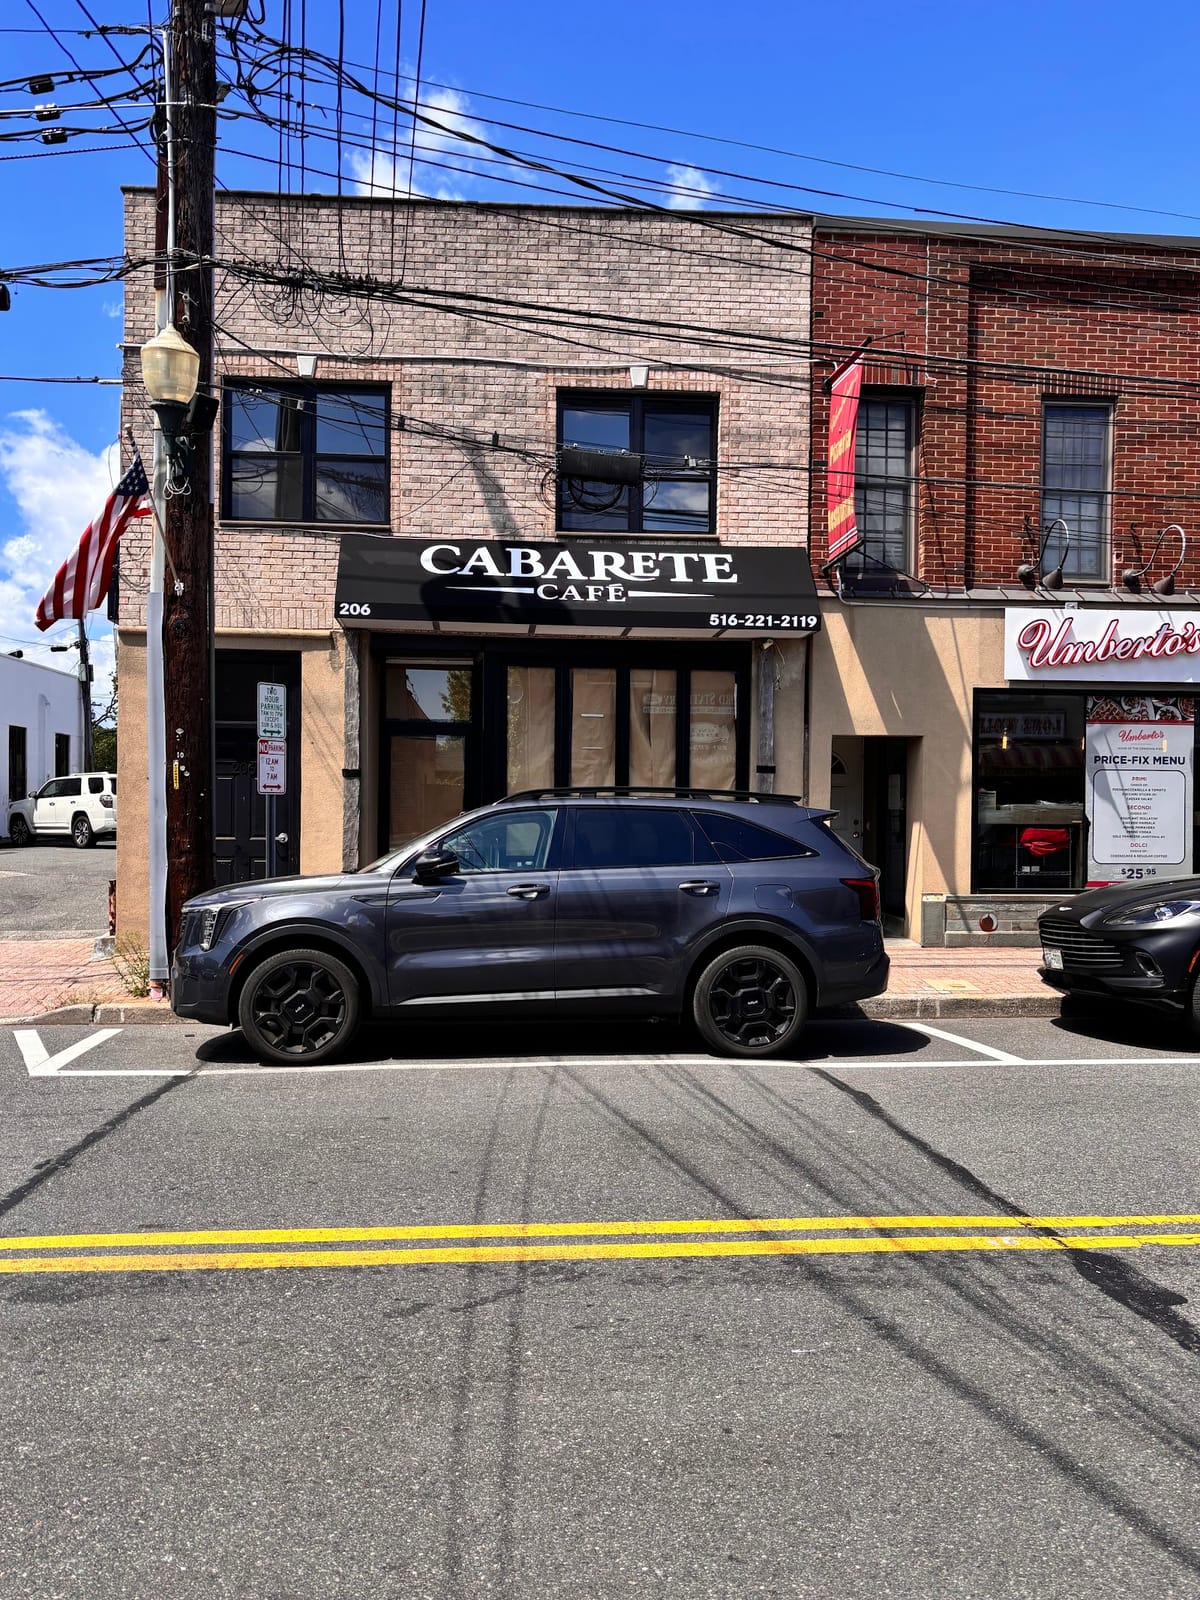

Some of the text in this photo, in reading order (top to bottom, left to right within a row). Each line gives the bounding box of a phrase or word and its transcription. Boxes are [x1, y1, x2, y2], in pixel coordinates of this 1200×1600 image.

[420, 544, 739, 584] CABARETE
[536, 582, 627, 603] CAFÉ
[339, 602, 371, 617] 206
[709, 613, 818, 628] 516-221-2119
[1017, 616, 1200, 670] Umberto's
[264, 695, 280, 704] HOUR
[260, 703, 284, 712] PARKING
[1118, 729, 1165, 743] Umberto's
[259, 741, 285, 753] NO PARKING
[1094, 755, 1186, 766] PRICE-FIX MENU
[1120, 868, 1157, 880] $25.95
